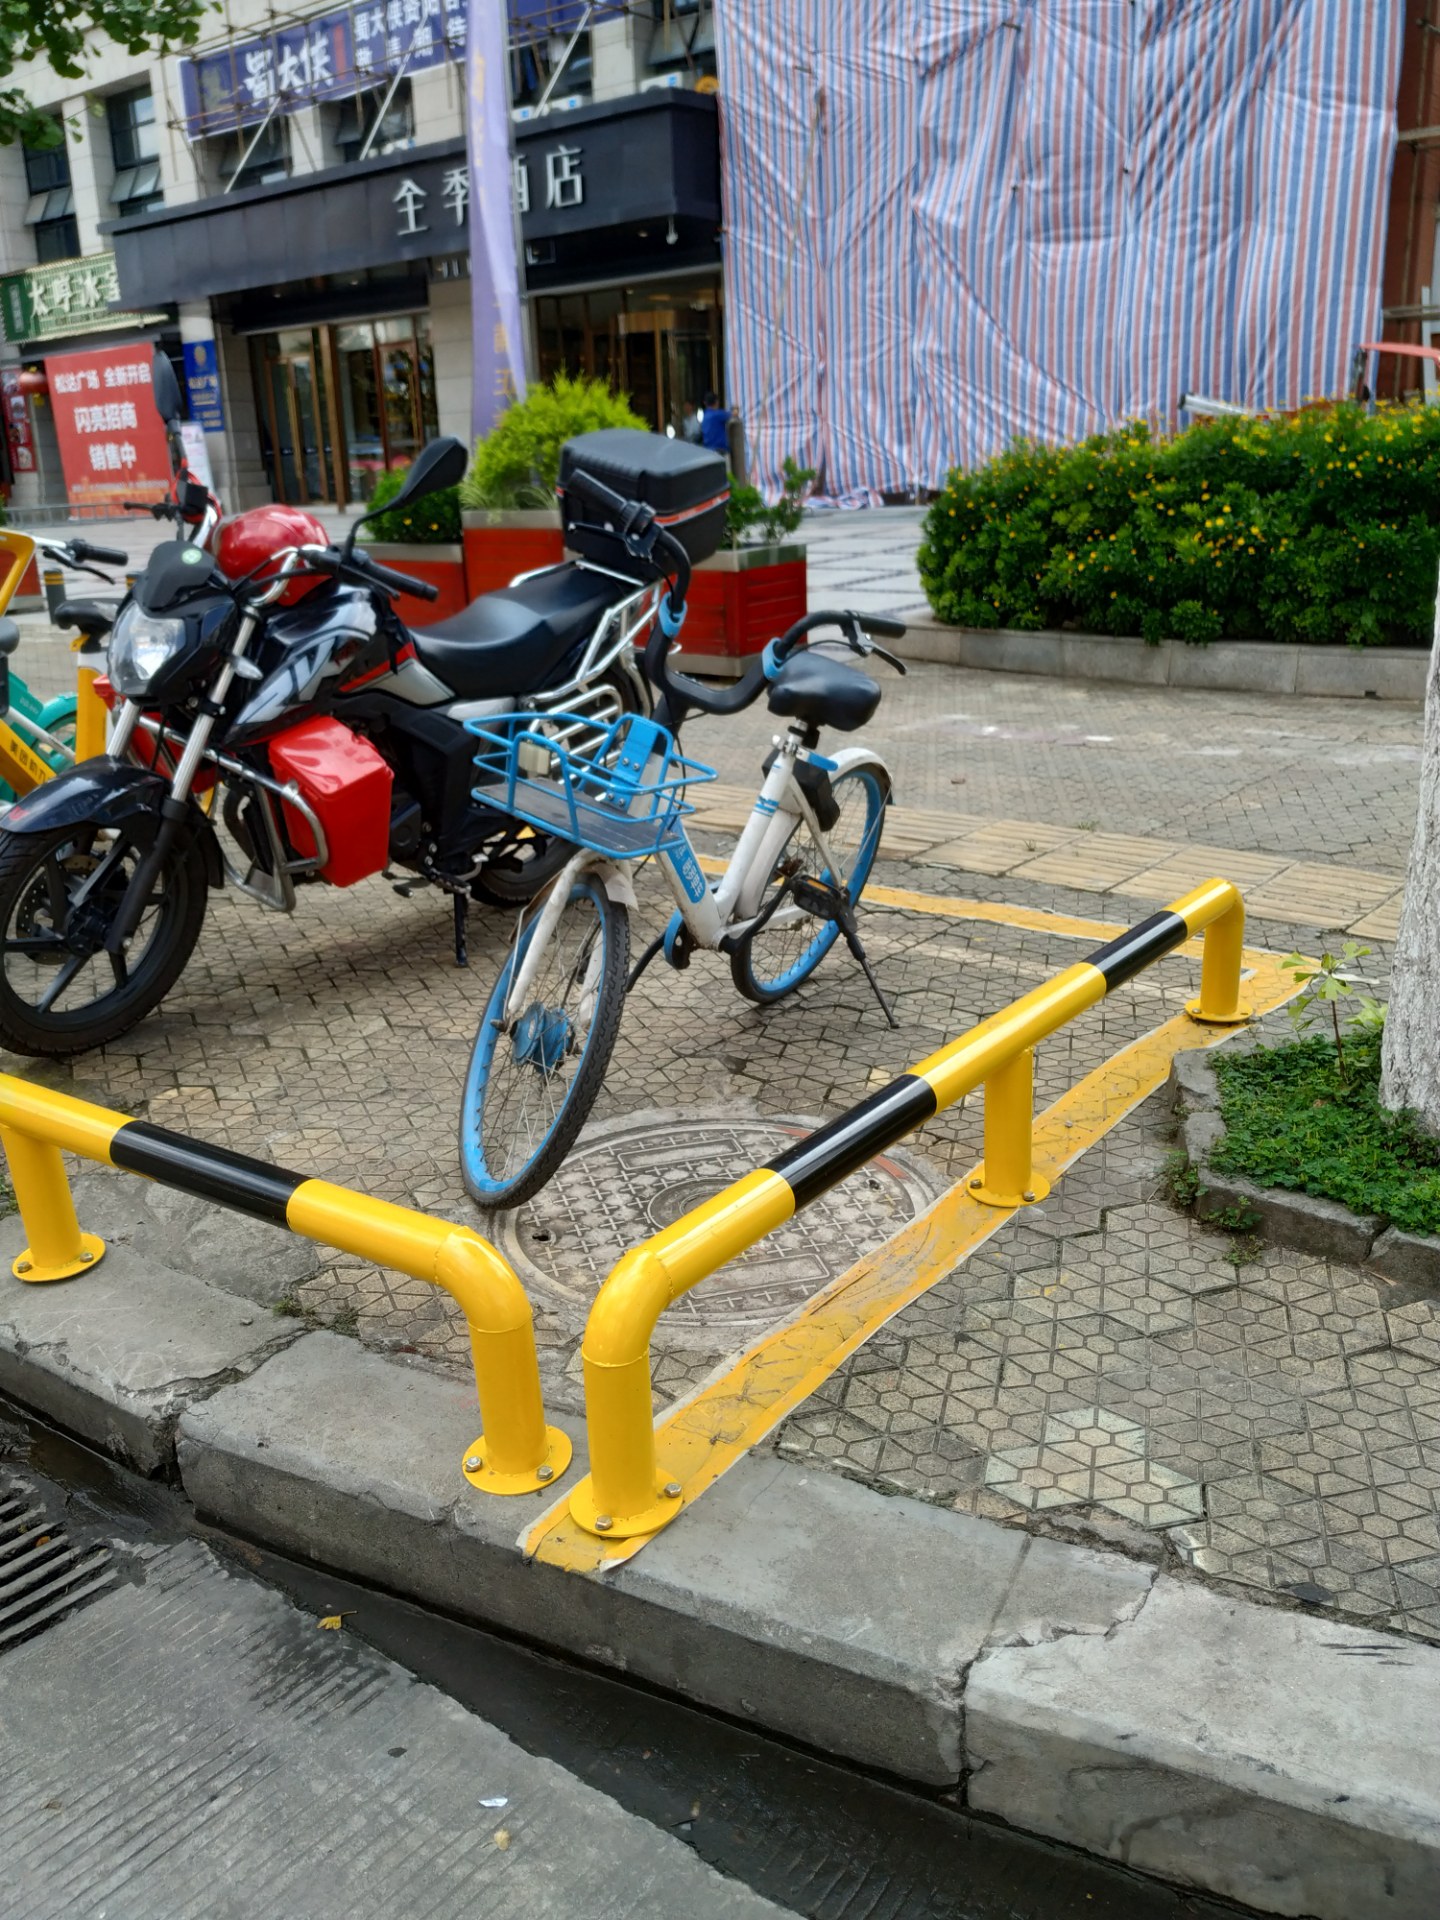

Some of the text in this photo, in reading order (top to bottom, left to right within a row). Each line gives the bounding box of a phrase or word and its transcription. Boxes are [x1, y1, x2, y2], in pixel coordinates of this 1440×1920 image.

[243, 31, 334, 106] 蜀大侠
[74, 401, 138, 434] 闪亮招商
[89, 441, 137, 471] 销售中
